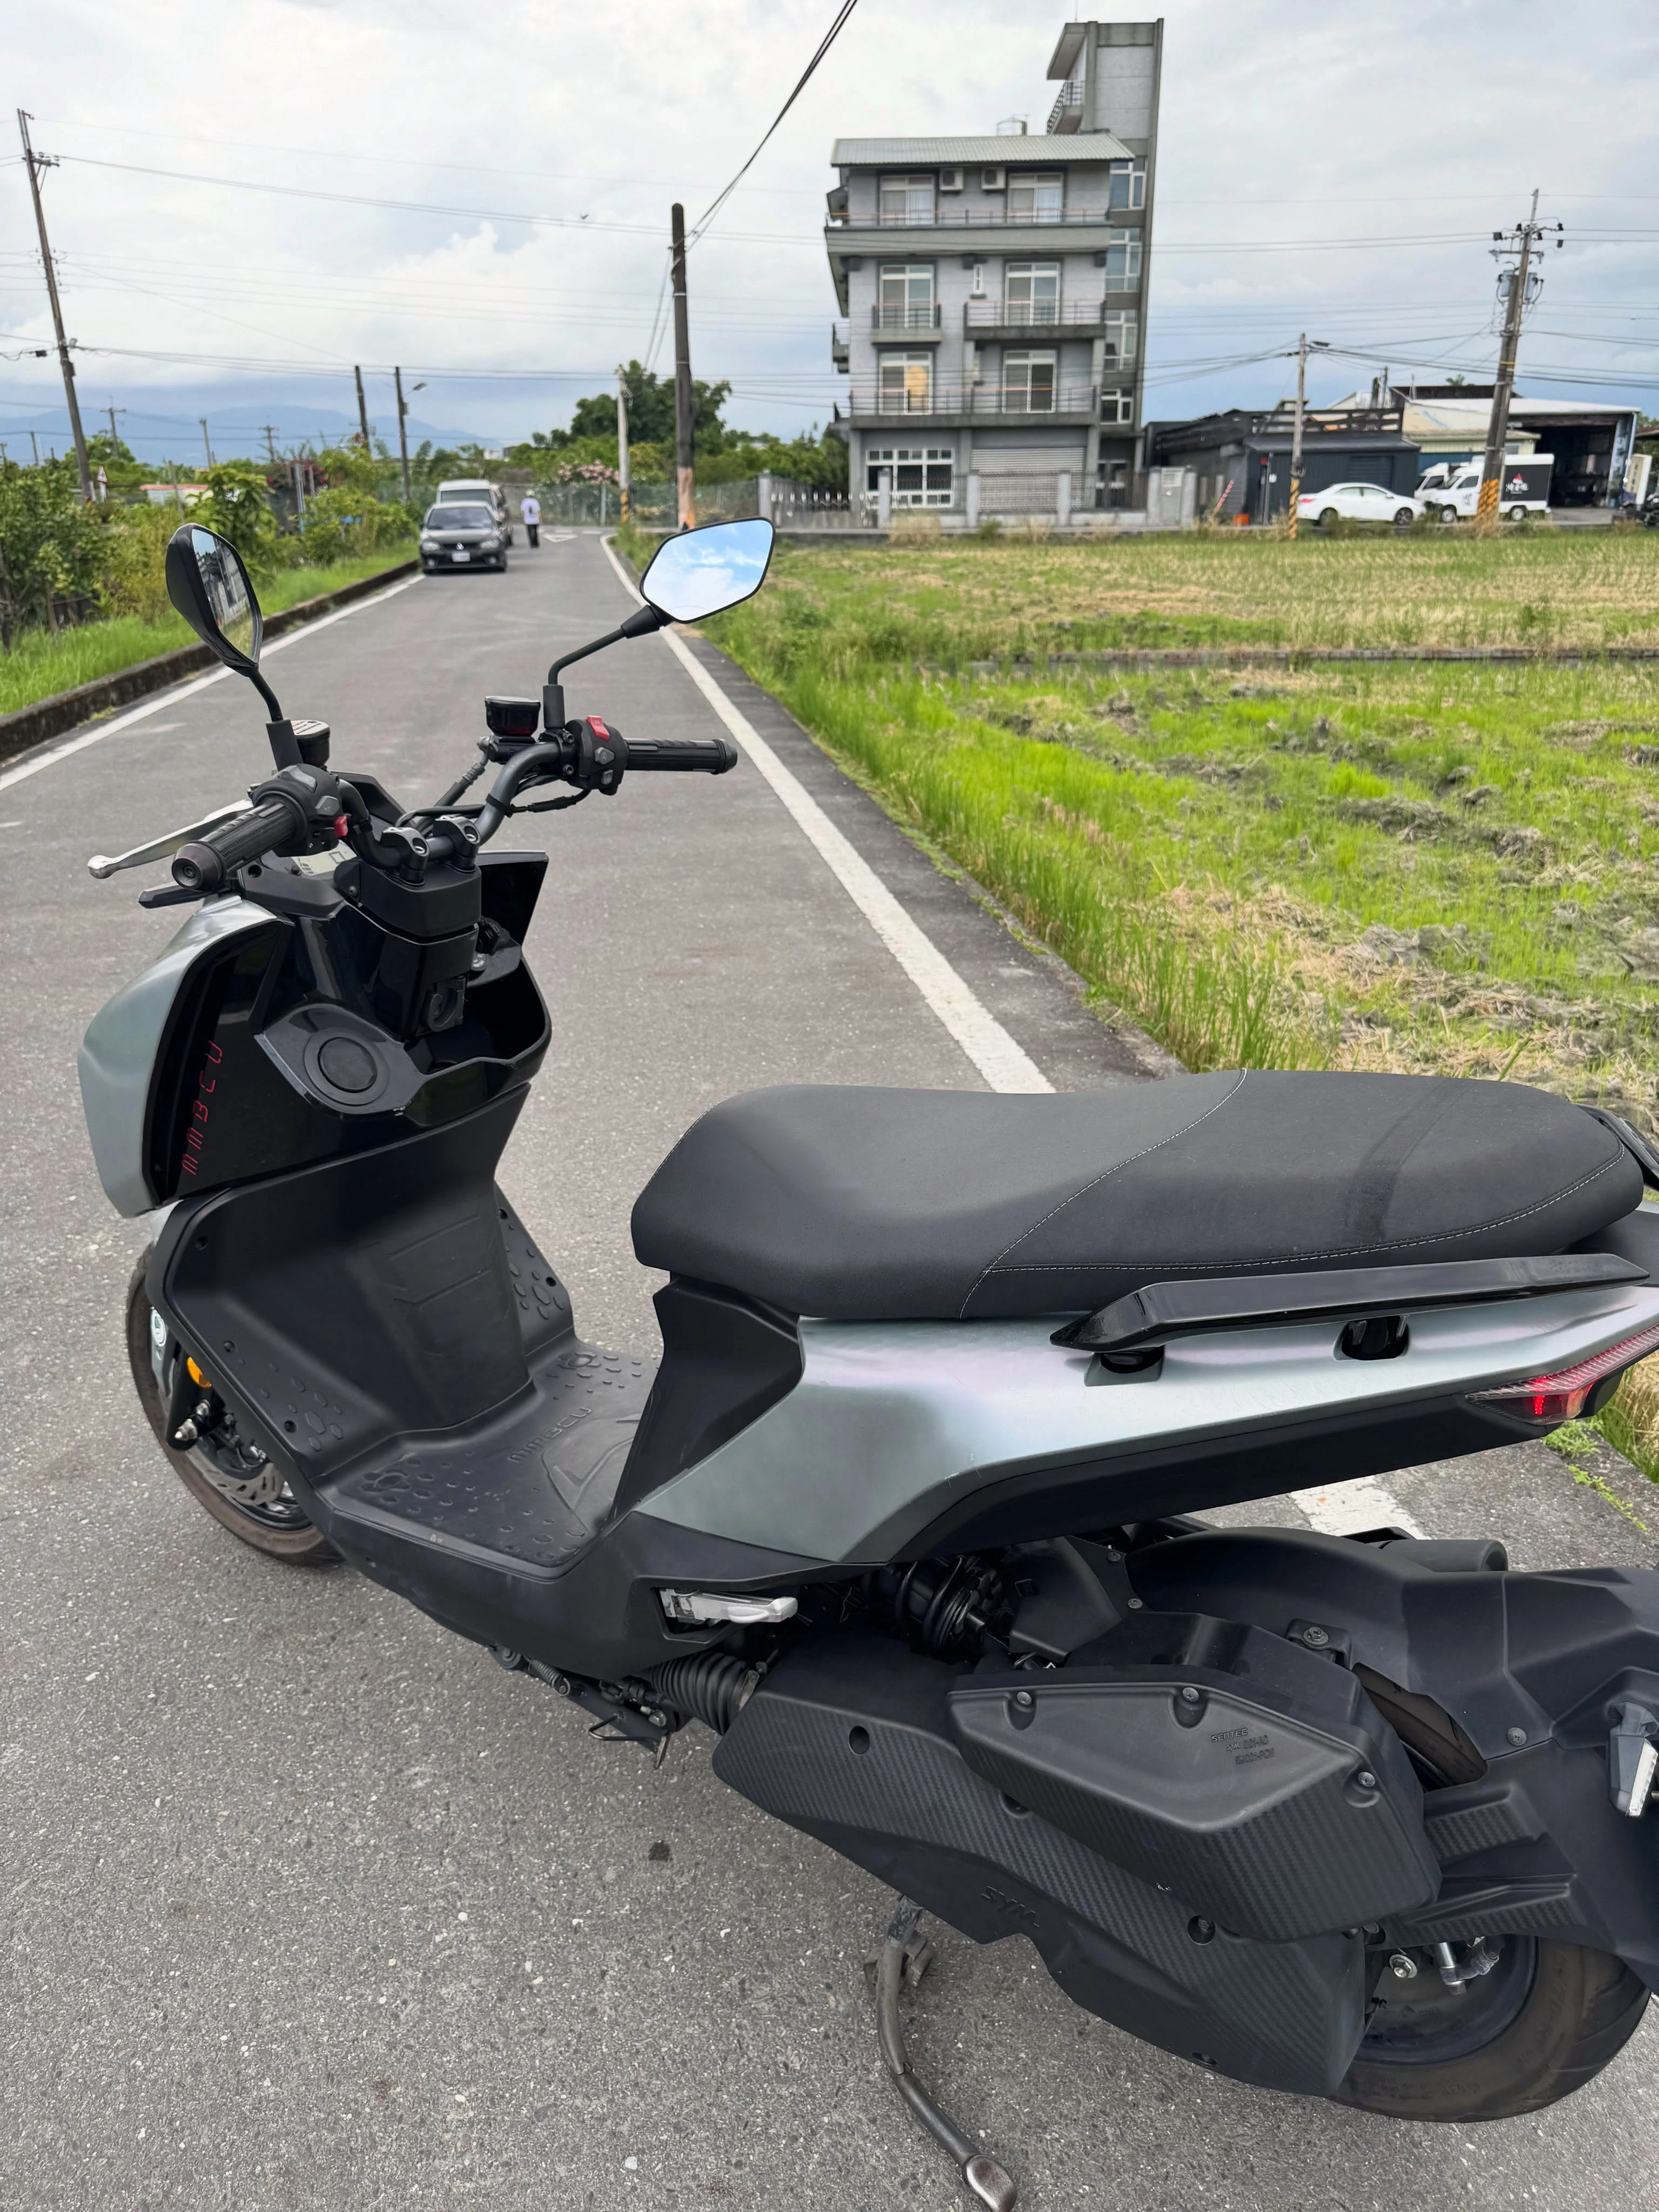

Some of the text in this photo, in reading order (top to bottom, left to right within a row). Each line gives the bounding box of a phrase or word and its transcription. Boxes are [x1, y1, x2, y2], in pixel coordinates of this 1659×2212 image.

[181, 1040, 222, 1176] MMBCU
[1211, 1728, 1248, 1742] SENTEC
[1226, 1742, 1240, 1752] SYM
[980, 1885, 1040, 1928] SYM
